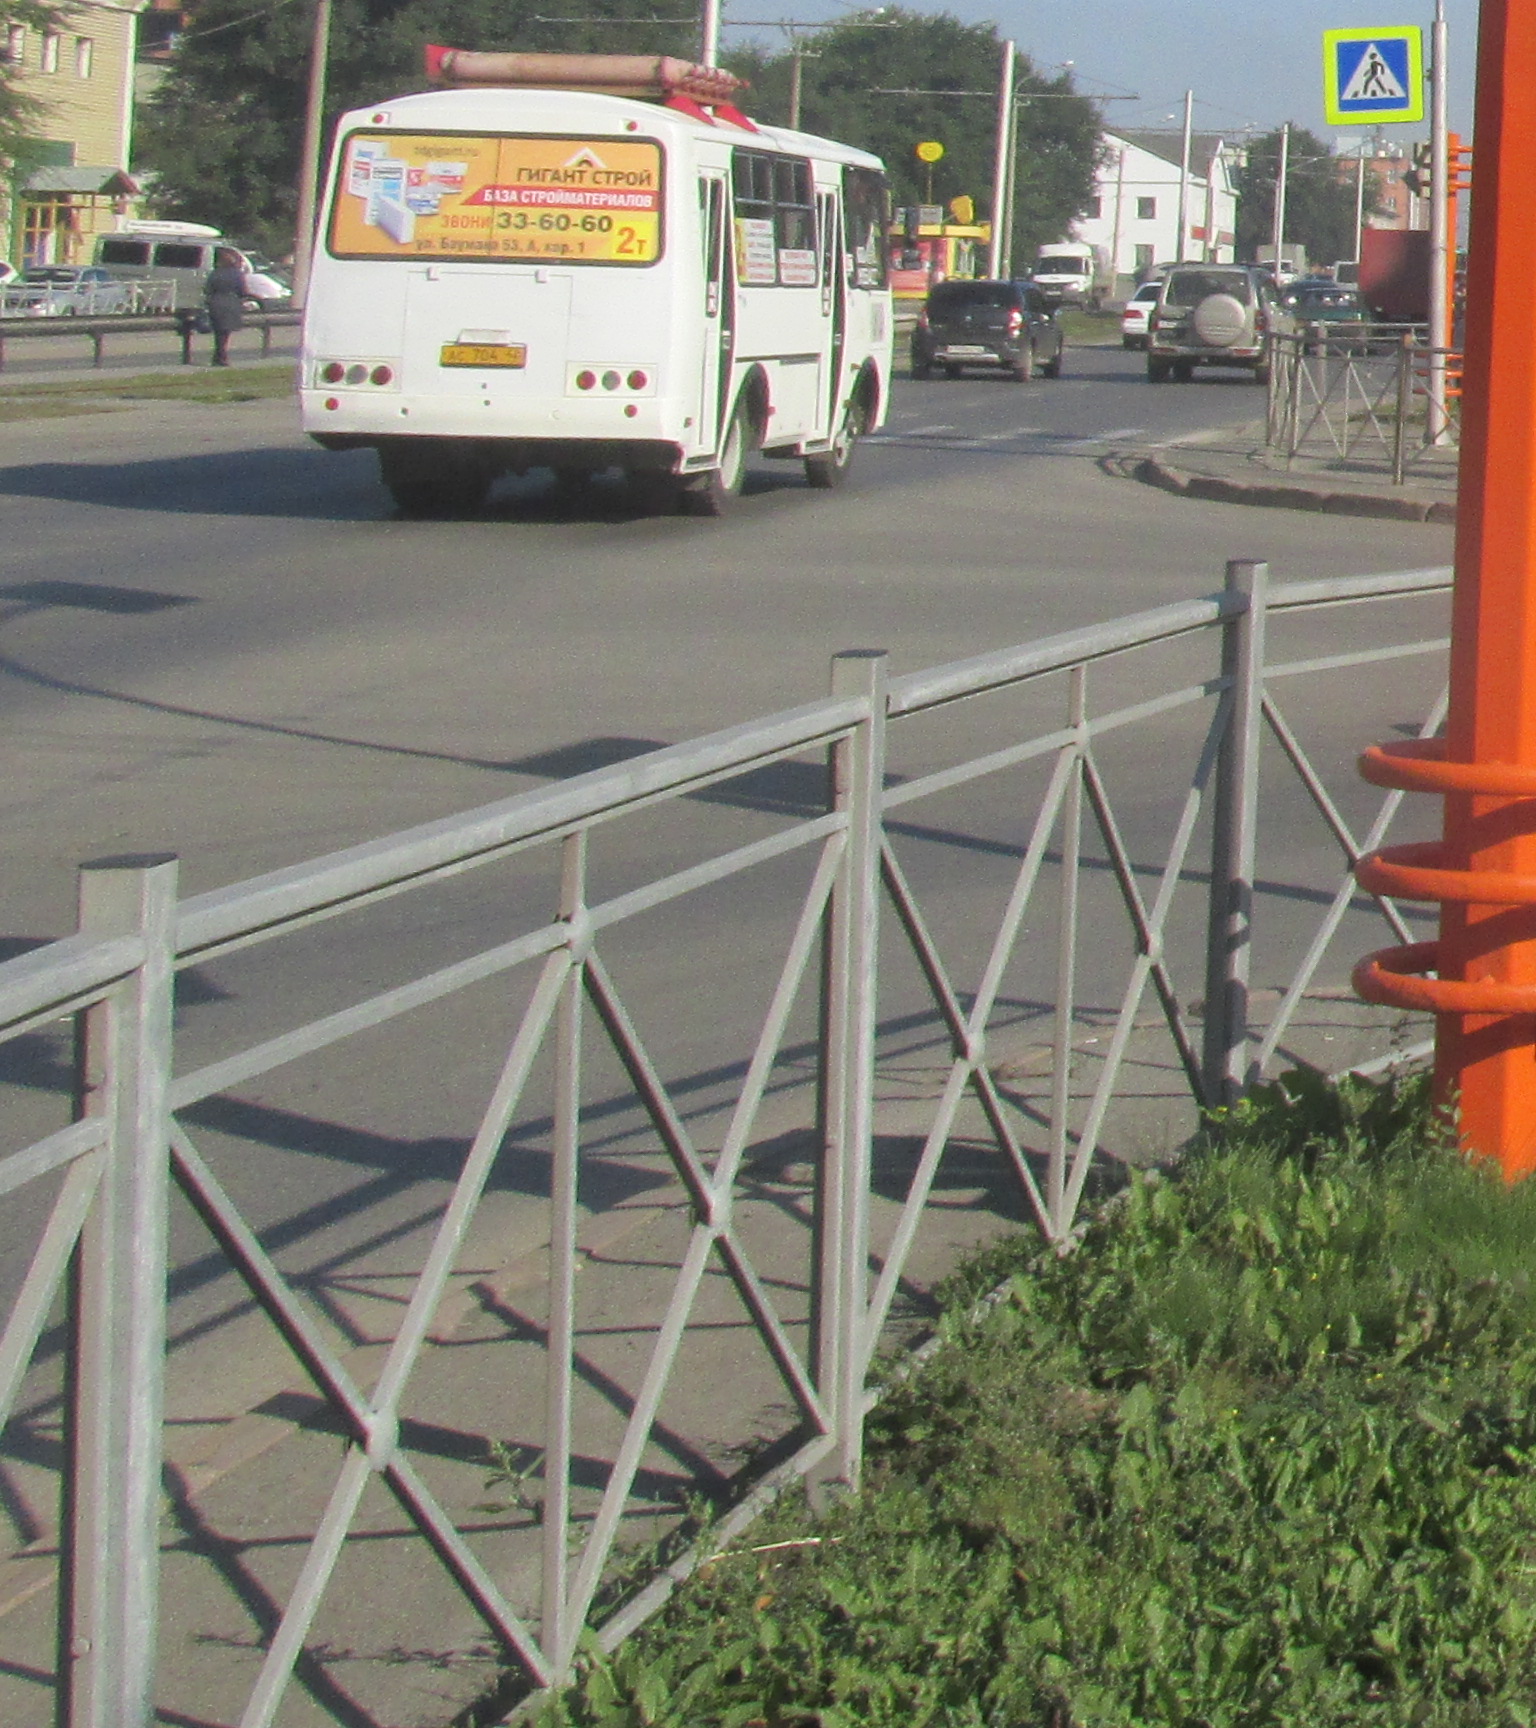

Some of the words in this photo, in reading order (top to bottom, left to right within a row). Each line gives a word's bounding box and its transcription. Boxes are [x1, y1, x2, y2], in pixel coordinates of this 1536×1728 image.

[517, 167, 587, 184] ГИГАНТ
[592, 168, 651, 186] СТРОЙ
[484, 189, 518, 202] БАЗА
[520, 189, 653, 207] СТРОЙМАТЕРИАЛОВ
[442, 214, 492, 229] ЗВОНИ
[496, 212, 613, 233] 33-60-60
